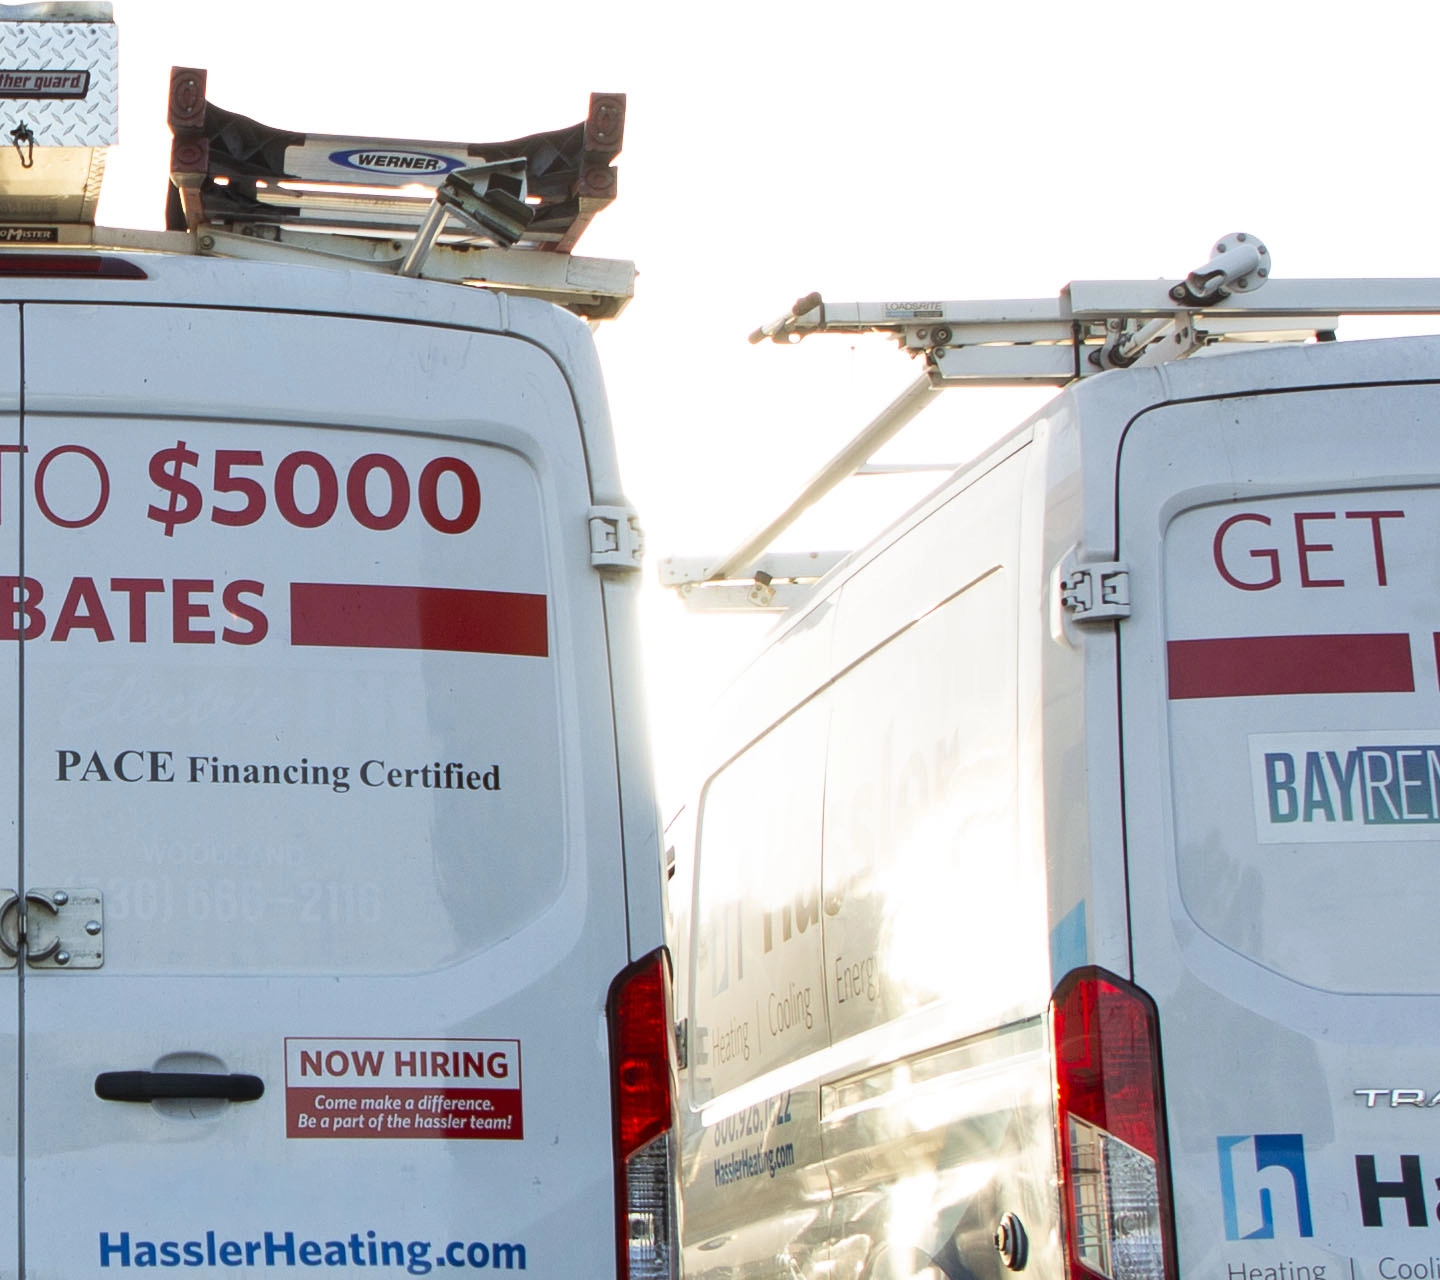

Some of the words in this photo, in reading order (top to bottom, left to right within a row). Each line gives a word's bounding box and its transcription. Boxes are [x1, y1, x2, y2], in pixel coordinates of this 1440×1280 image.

[34, 74, 81, 90] guard
[358, 153, 440, 170] WERNER
[146, 440, 482, 537] $5000
[1211, 510, 1406, 592] GET
[56, 749, 175, 783] PACE
[187, 755, 351, 794] Financing
[359, 757, 502, 792] Certified
[767, 981, 814, 1037] Cooling
[299, 1050, 387, 1078] NOW
[393, 1051, 510, 1080] HIRING
[314, 1094, 358, 1111] Come
[361, 1093, 403, 1111] make
[405, 1098, 416, 1111] a
[417, 1093, 496, 1115] difference.
[297, 1113, 317, 1129] Be
[318, 1117, 330, 1129] a
[331, 1114, 365, 1132] part
[366, 1113, 385, 1133] of
[386, 1113, 411, 1130] the
[413, 1113, 468, 1131] hassler
[469, 1114, 514, 1131] team!
[98, 1229, 528, 1275] HasslerHeating.com
